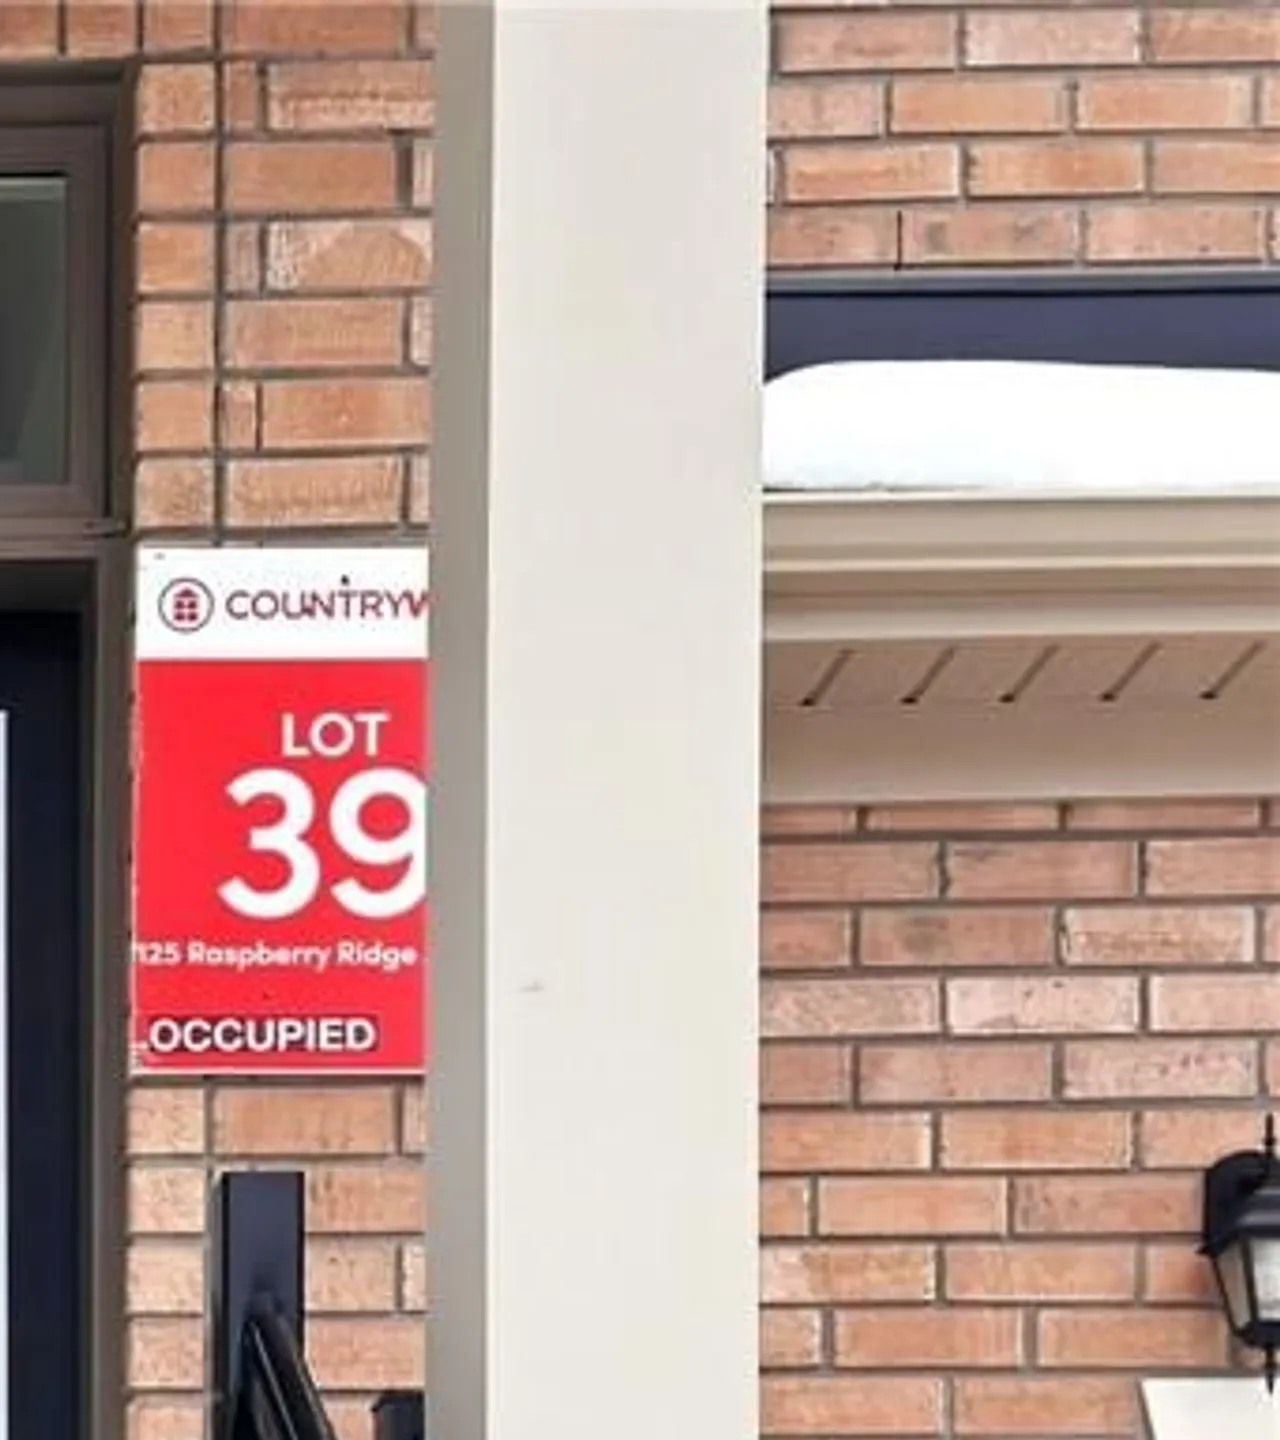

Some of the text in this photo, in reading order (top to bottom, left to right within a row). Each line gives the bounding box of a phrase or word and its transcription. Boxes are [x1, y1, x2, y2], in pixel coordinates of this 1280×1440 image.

[281, 712, 391, 758] LOT
[216, 767, 427, 920] 39
[187, 939, 331, 974] Raspberry
[337, 939, 418, 973] Ridge
[149, 1018, 376, 1052] OCCUPIED
